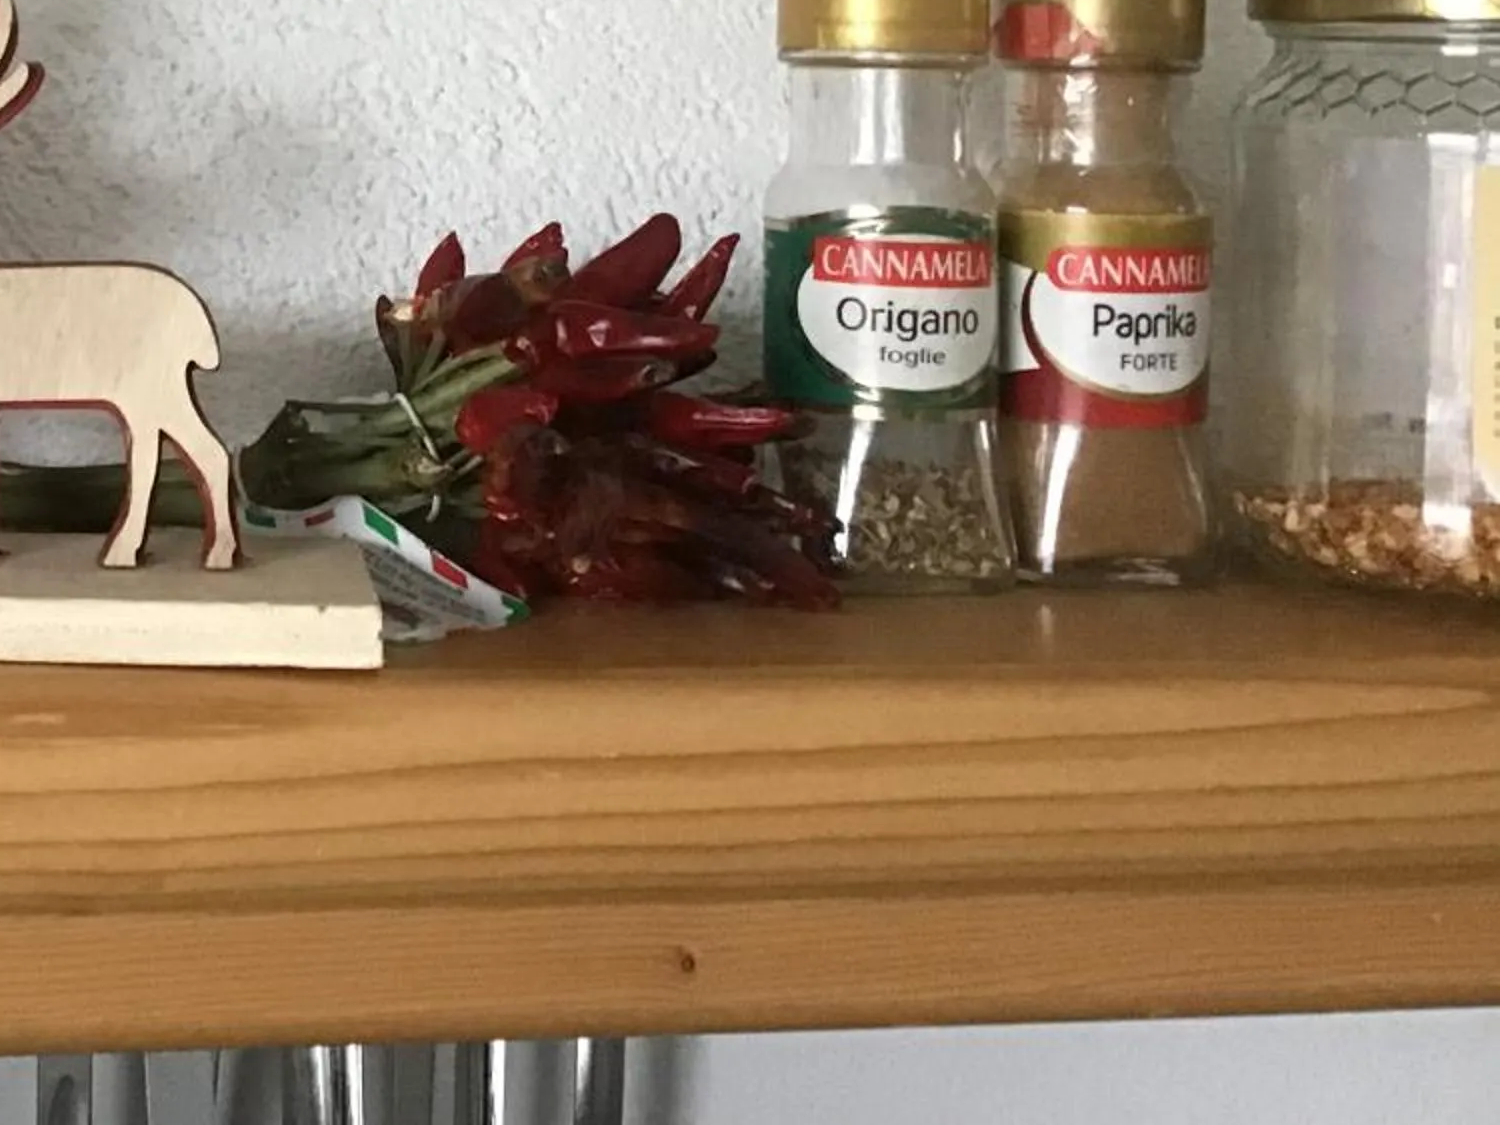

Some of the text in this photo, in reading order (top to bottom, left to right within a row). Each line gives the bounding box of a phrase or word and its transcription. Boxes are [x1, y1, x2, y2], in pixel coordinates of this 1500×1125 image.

[821, 244, 989, 282] CANNAMELA
[836, 296, 980, 342] Origano
[1092, 303, 1197, 346] Paprika
[879, 346, 947, 369] foglie
[1119, 353, 1179, 371] FORTE
